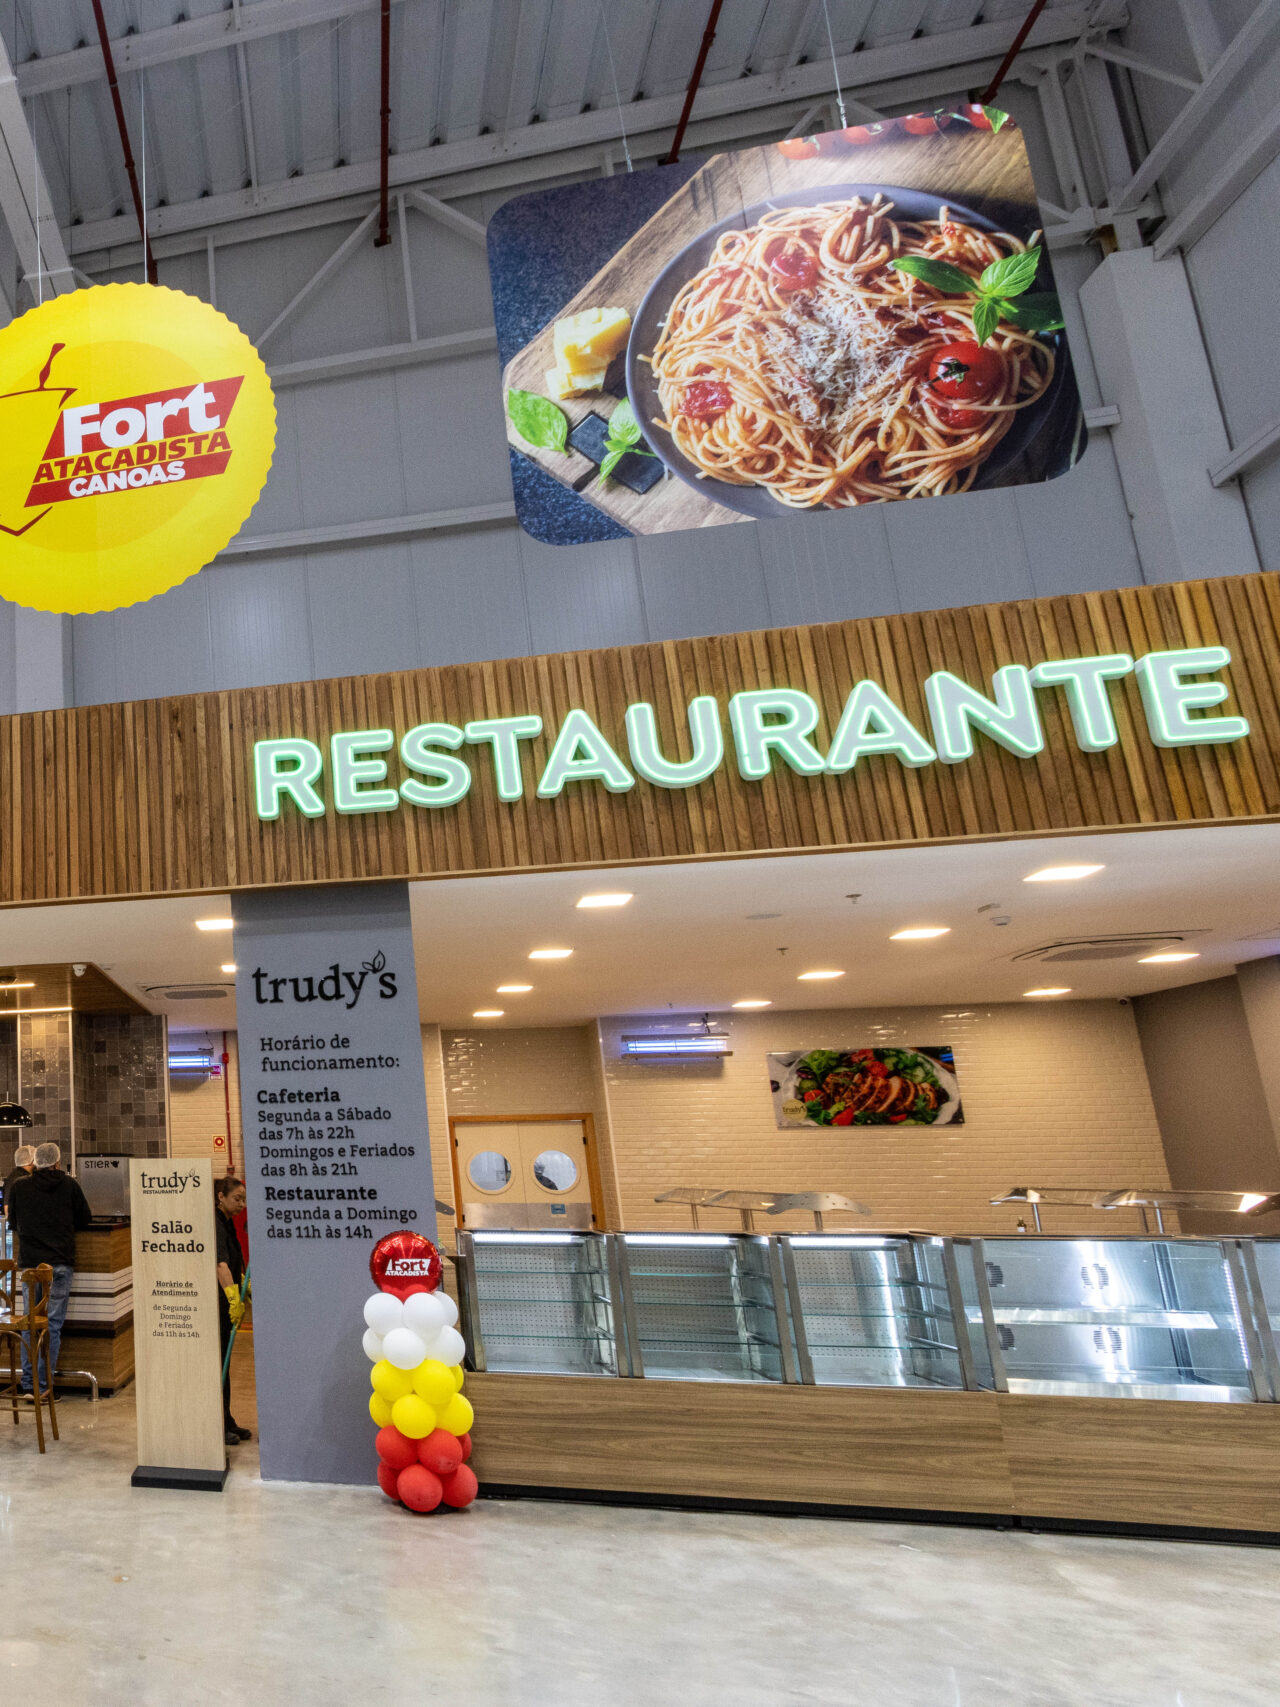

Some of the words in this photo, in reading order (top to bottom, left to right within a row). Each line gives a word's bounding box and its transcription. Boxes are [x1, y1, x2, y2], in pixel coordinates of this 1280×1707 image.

[63, 382, 220, 457] Fort
[33, 431, 231, 483] ATACADISTA
[68, 461, 185, 498] CANOAS
[253, 645, 1249, 821] RESTAURANTE
[252, 963, 398, 1010] trudy's
[260, 1034, 325, 1051] Horário
[330, 1034, 350, 1049] de
[261, 1054, 400, 1072] funcionamento:
[257, 1087, 340, 1104] Cafeteria
[258, 1110, 321, 1125] Segunda
[325, 1111, 333, 1121] a
[337, 1107, 391, 1121] Sábado
[259, 1128, 283, 1140] das
[286, 1127, 304, 1140] 7h
[308, 1127, 324, 1140] às
[327, 1126, 355, 1139] 22h
[260, 1146, 334, 1160] Domingos
[338, 1148, 346, 1157] e
[350, 1143, 415, 1157] Feriados
[261, 1164, 285, 1177] das
[289, 1163, 308, 1176] 8h
[312, 1162, 328, 1176] às
[331, 1162, 358, 1175] 21h
[140, 1171, 201, 1194] trudy's
[265, 1186, 378, 1201] Restaurante
[266, 1207, 330, 1224] Segunda
[335, 1209, 343, 1220] a
[347, 1206, 418, 1224] Domingo
[151, 1221, 193, 1235] Salão
[267, 1225, 292, 1239] das
[295, 1225, 321, 1239] 11h
[325, 1224, 342, 1239] às
[346, 1225, 373, 1239] 14h
[141, 1240, 205, 1254] Fechado
[391, 1258, 426, 1271] Fort
[156, 1280, 183, 1288] Horário
[151, 1289, 198, 1297] Atendimento
[163, 1304, 192, 1312] Segunda
[160, 1313, 191, 1321] Domingo
[164, 1321, 193, 1329] Feriados
